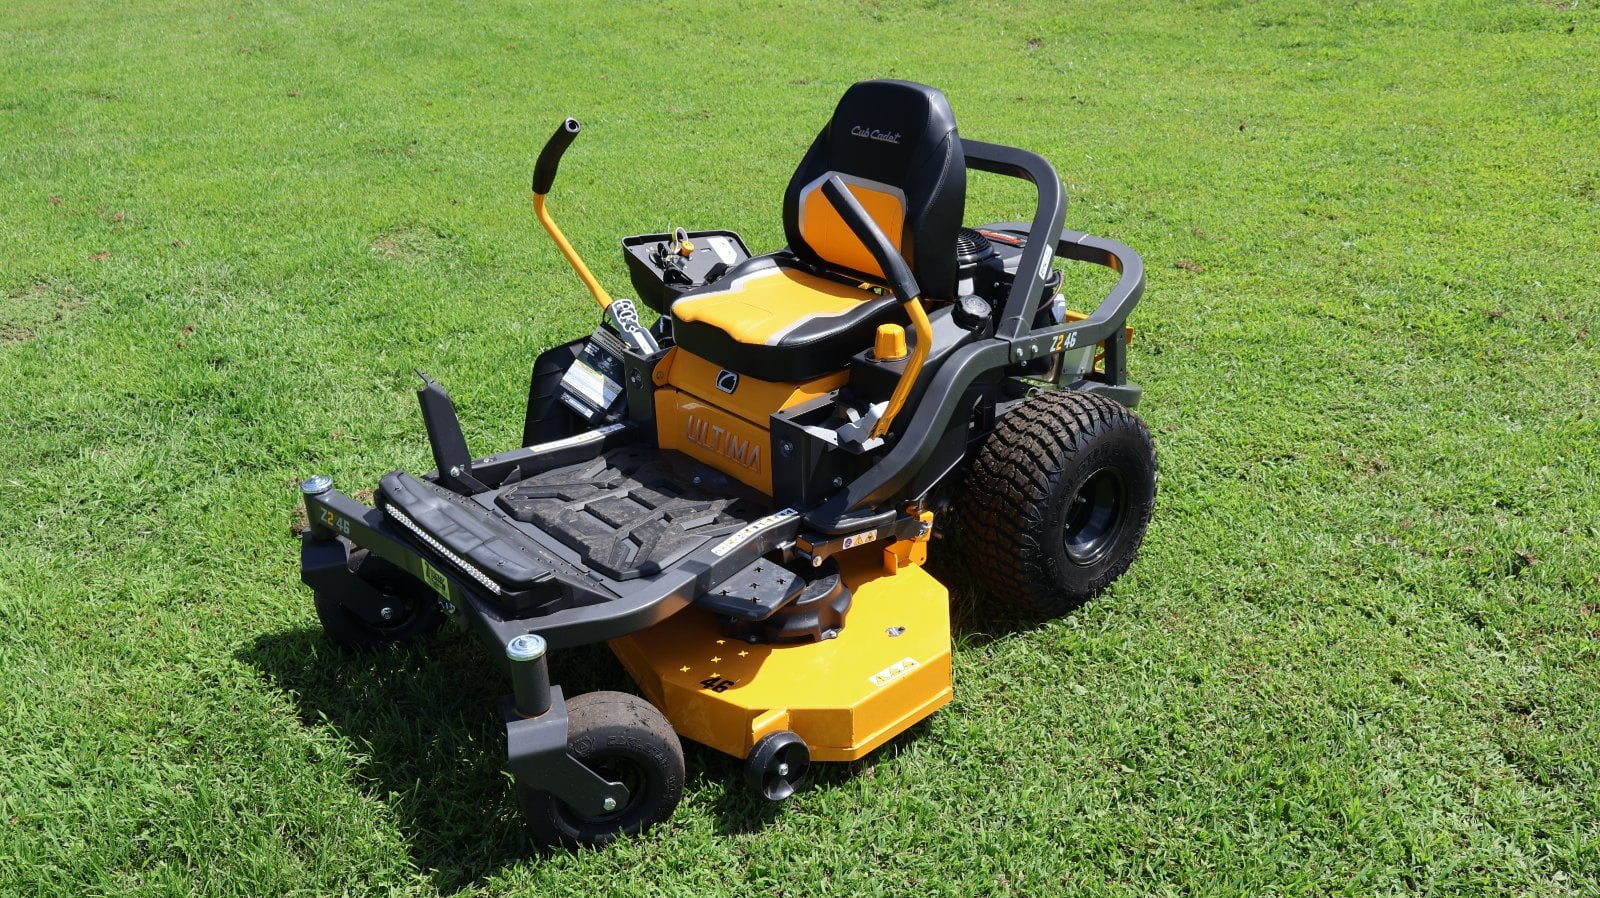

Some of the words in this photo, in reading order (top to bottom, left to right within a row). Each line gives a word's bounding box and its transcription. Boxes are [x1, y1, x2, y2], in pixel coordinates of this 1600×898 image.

[851, 126, 870, 138] Cub
[870, 129, 901, 144] Cadet
[1050, 335, 1064, 352] Z2
[1064, 331, 1078, 349] 46
[687, 415, 761, 475] ULTIMA
[320, 506, 334, 526] Z2
[336, 517, 350, 535] 46
[700, 677, 735, 693] 46
